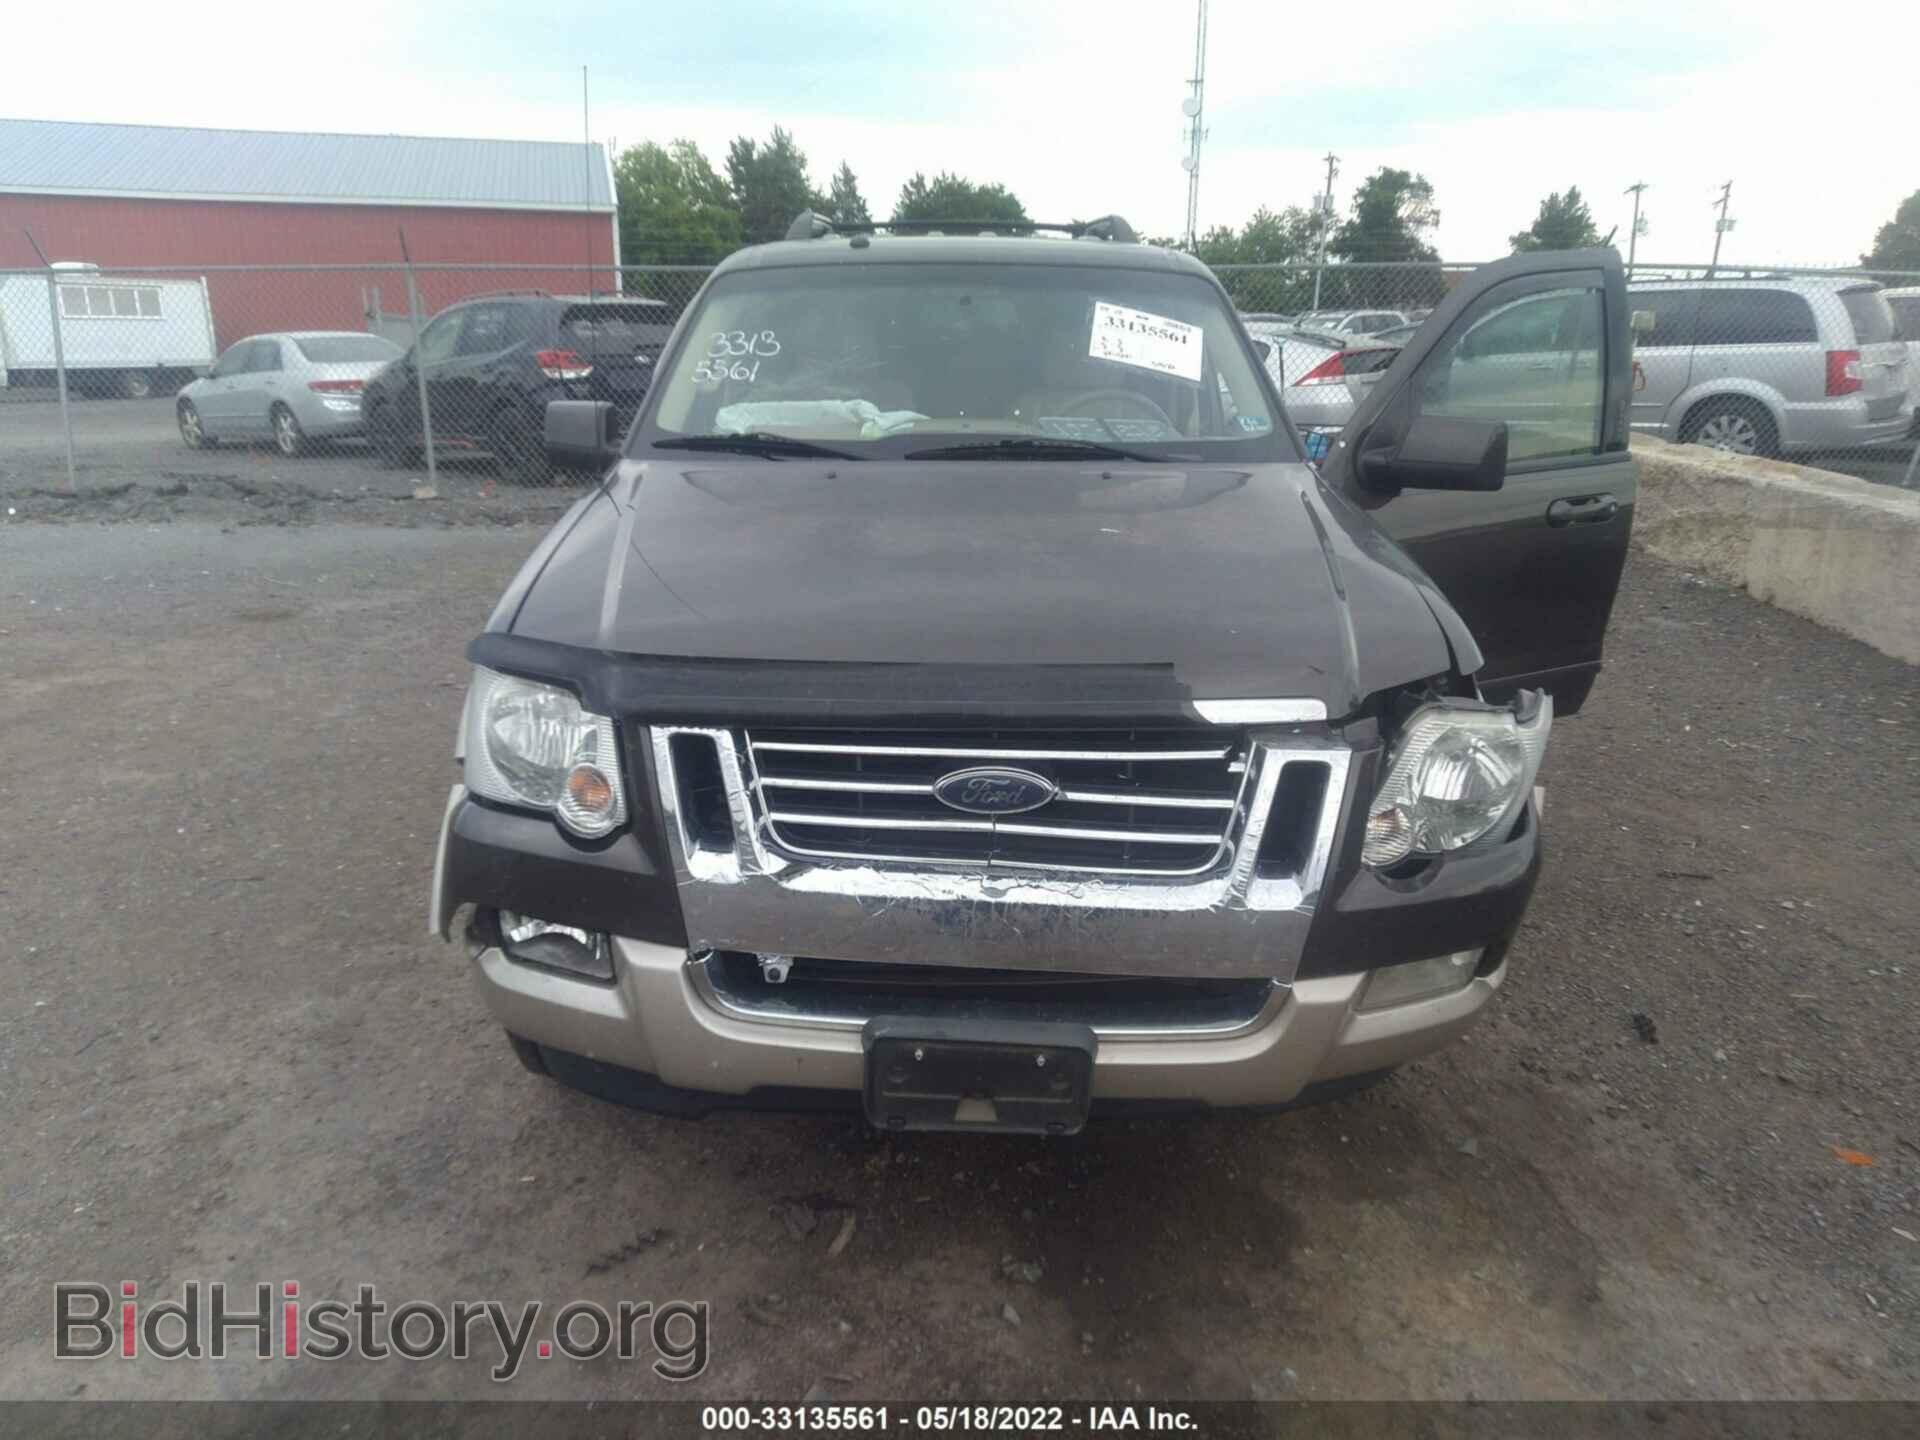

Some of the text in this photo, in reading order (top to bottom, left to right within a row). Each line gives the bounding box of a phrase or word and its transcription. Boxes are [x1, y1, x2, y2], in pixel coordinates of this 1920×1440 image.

[707, 330, 781, 357] 3313
[691, 359, 760, 383] 5561
[961, 777, 1027, 804] Ford
